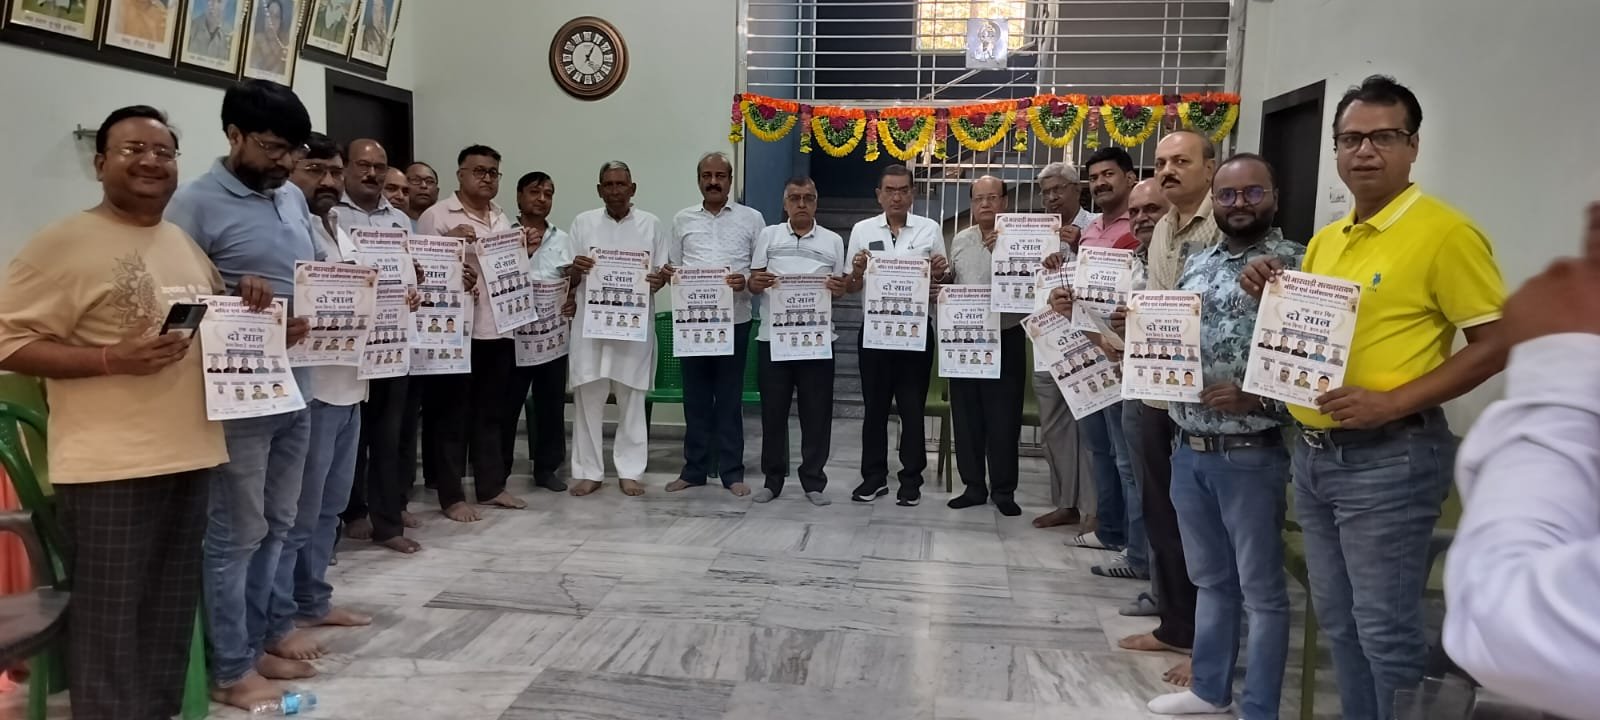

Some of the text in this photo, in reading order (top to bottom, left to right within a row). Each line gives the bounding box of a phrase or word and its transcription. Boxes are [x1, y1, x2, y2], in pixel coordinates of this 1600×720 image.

[883, 283, 891, 291] दो
[316, 295, 327, 303] दो
[688, 292, 696, 300] दो
[1286, 310, 1330, 328] दो साल
[1146, 322, 1156, 331] दो
[228, 331, 263, 342] दो साल
[1058, 330, 1082, 345] दो सा
